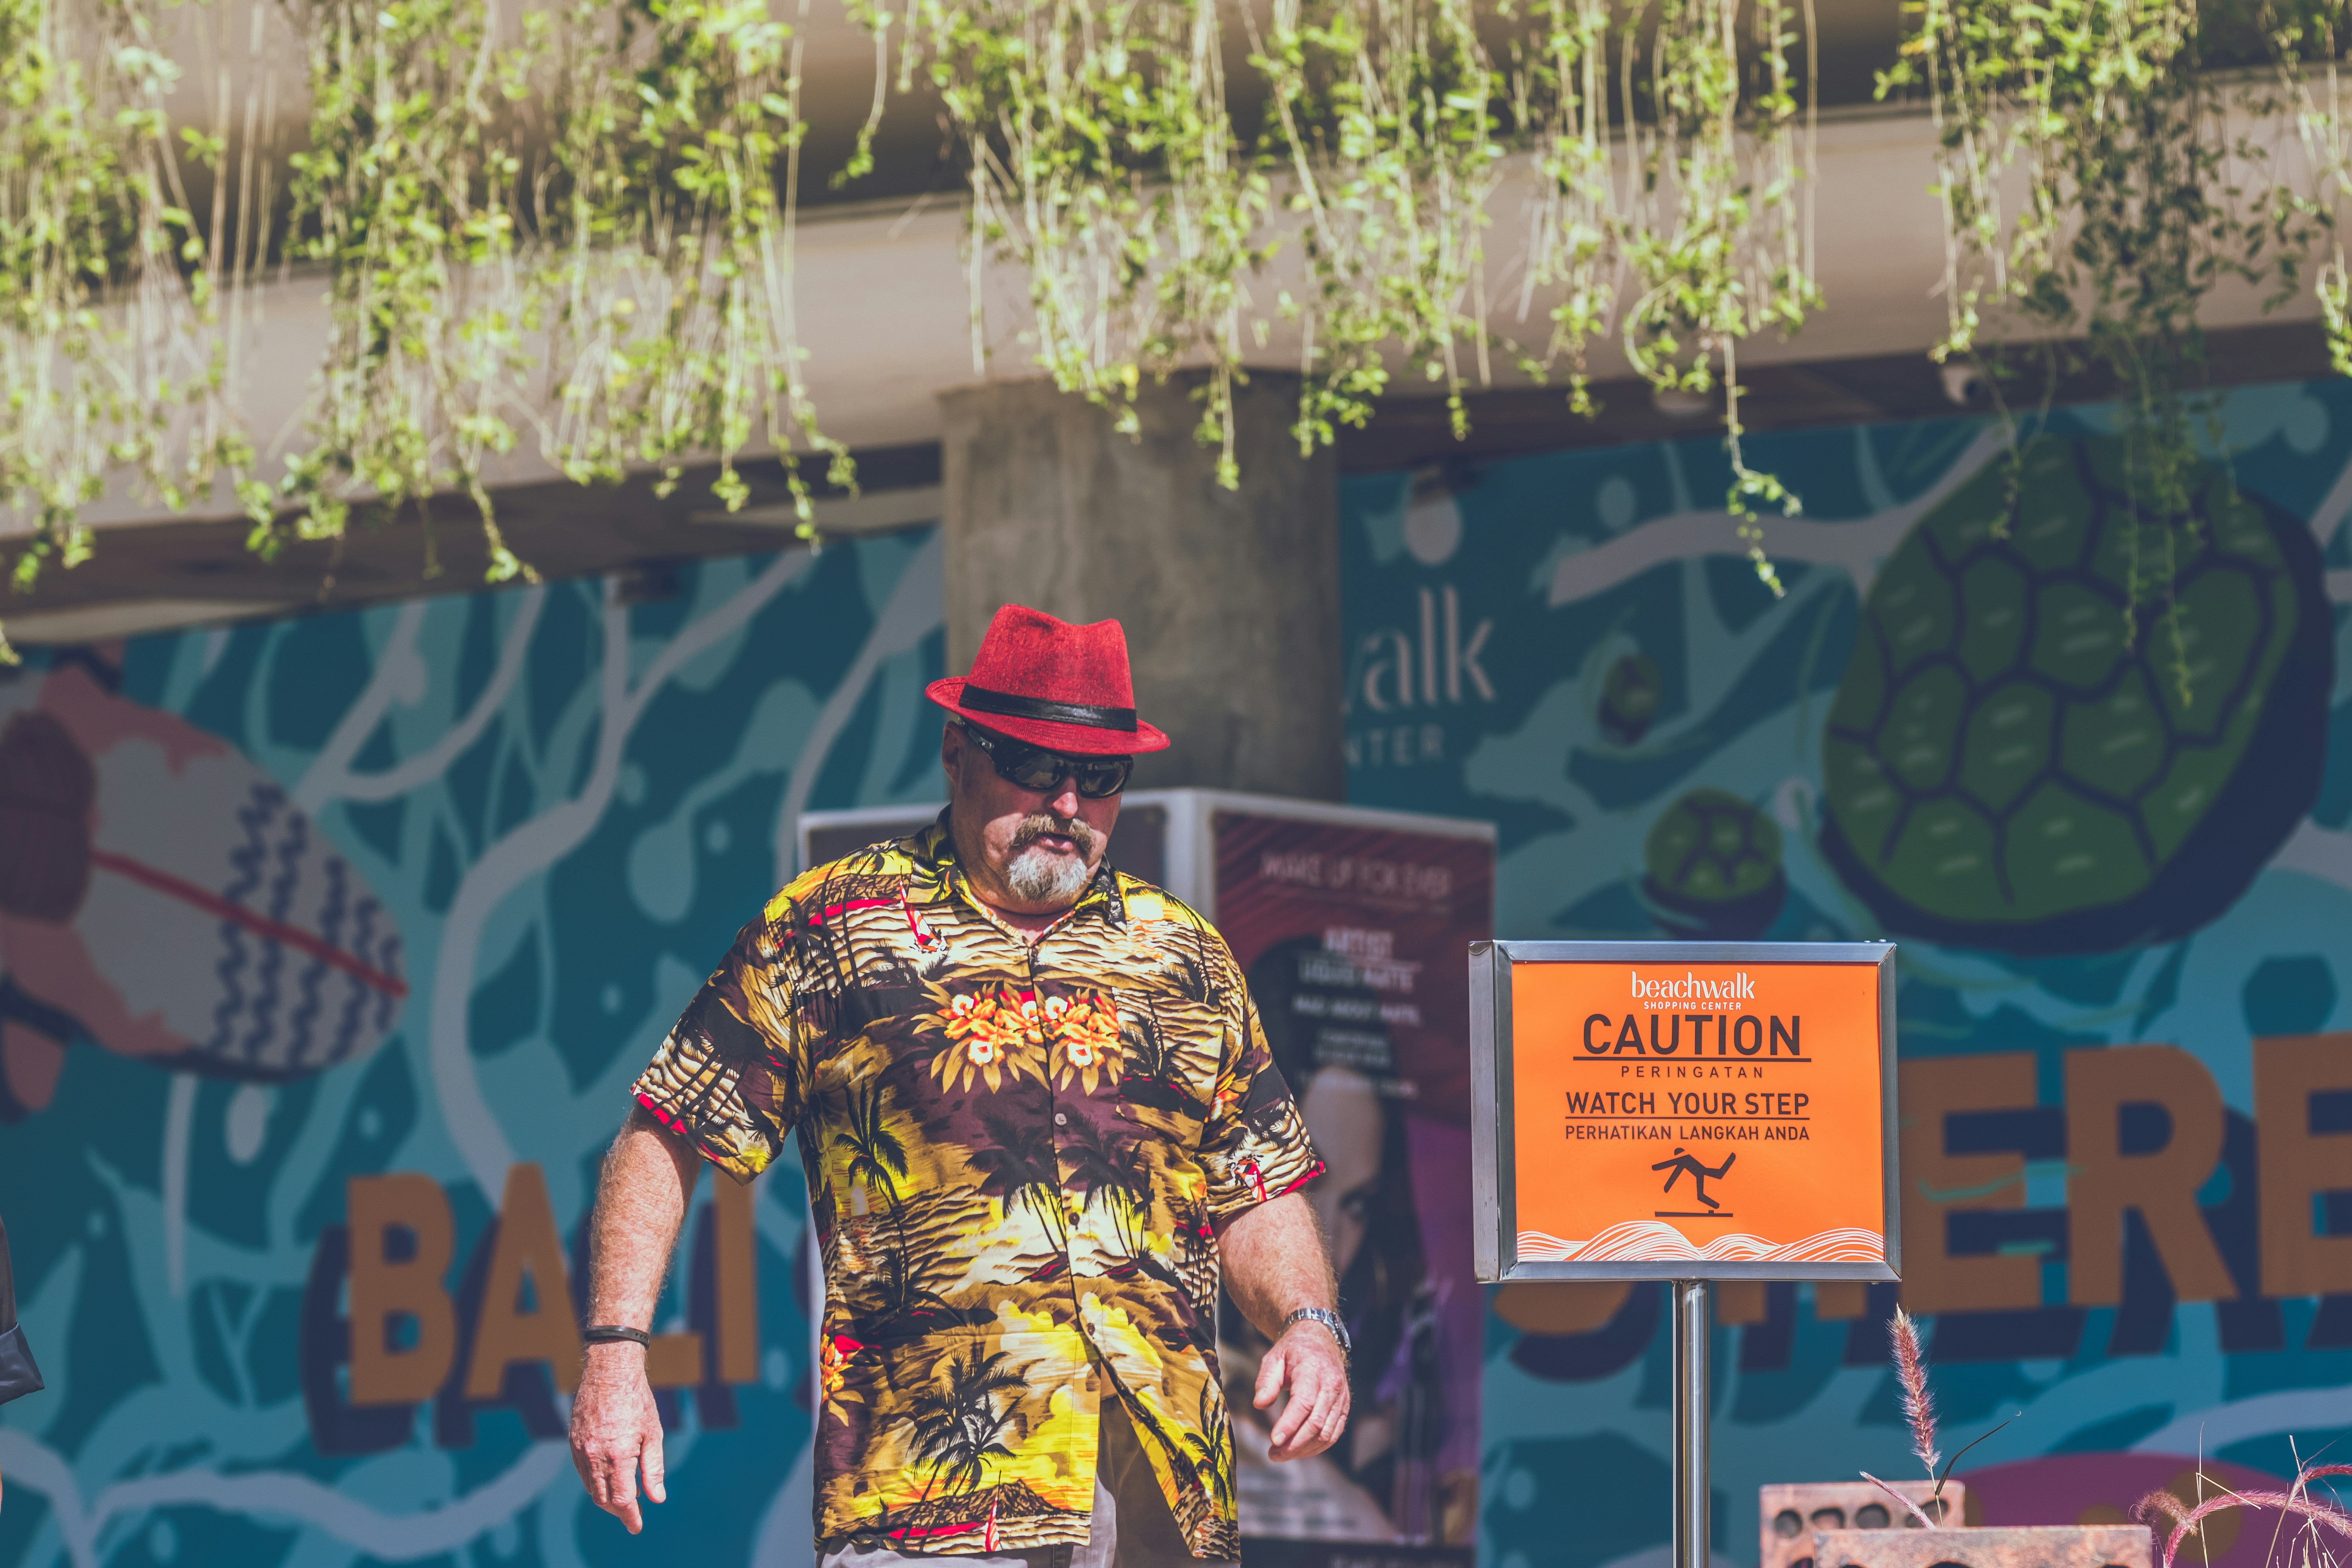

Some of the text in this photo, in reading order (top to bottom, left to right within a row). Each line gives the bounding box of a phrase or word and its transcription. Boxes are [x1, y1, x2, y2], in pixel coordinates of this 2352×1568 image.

[1339, 584, 1495, 715] alk
[1632, 971, 1755, 999] beachwalk
[1644, 1001, 1741, 1010] SHOPPING CENTER
[1583, 1014, 1800, 1056] CAUTION
[1622, 1066, 1763, 1078] PERINGATAN
[1566, 1092, 1809, 1115] WATCH YOUR STEP
[1566, 1125, 1809, 1140] PERHATIKAN LANGKAH ANDA
